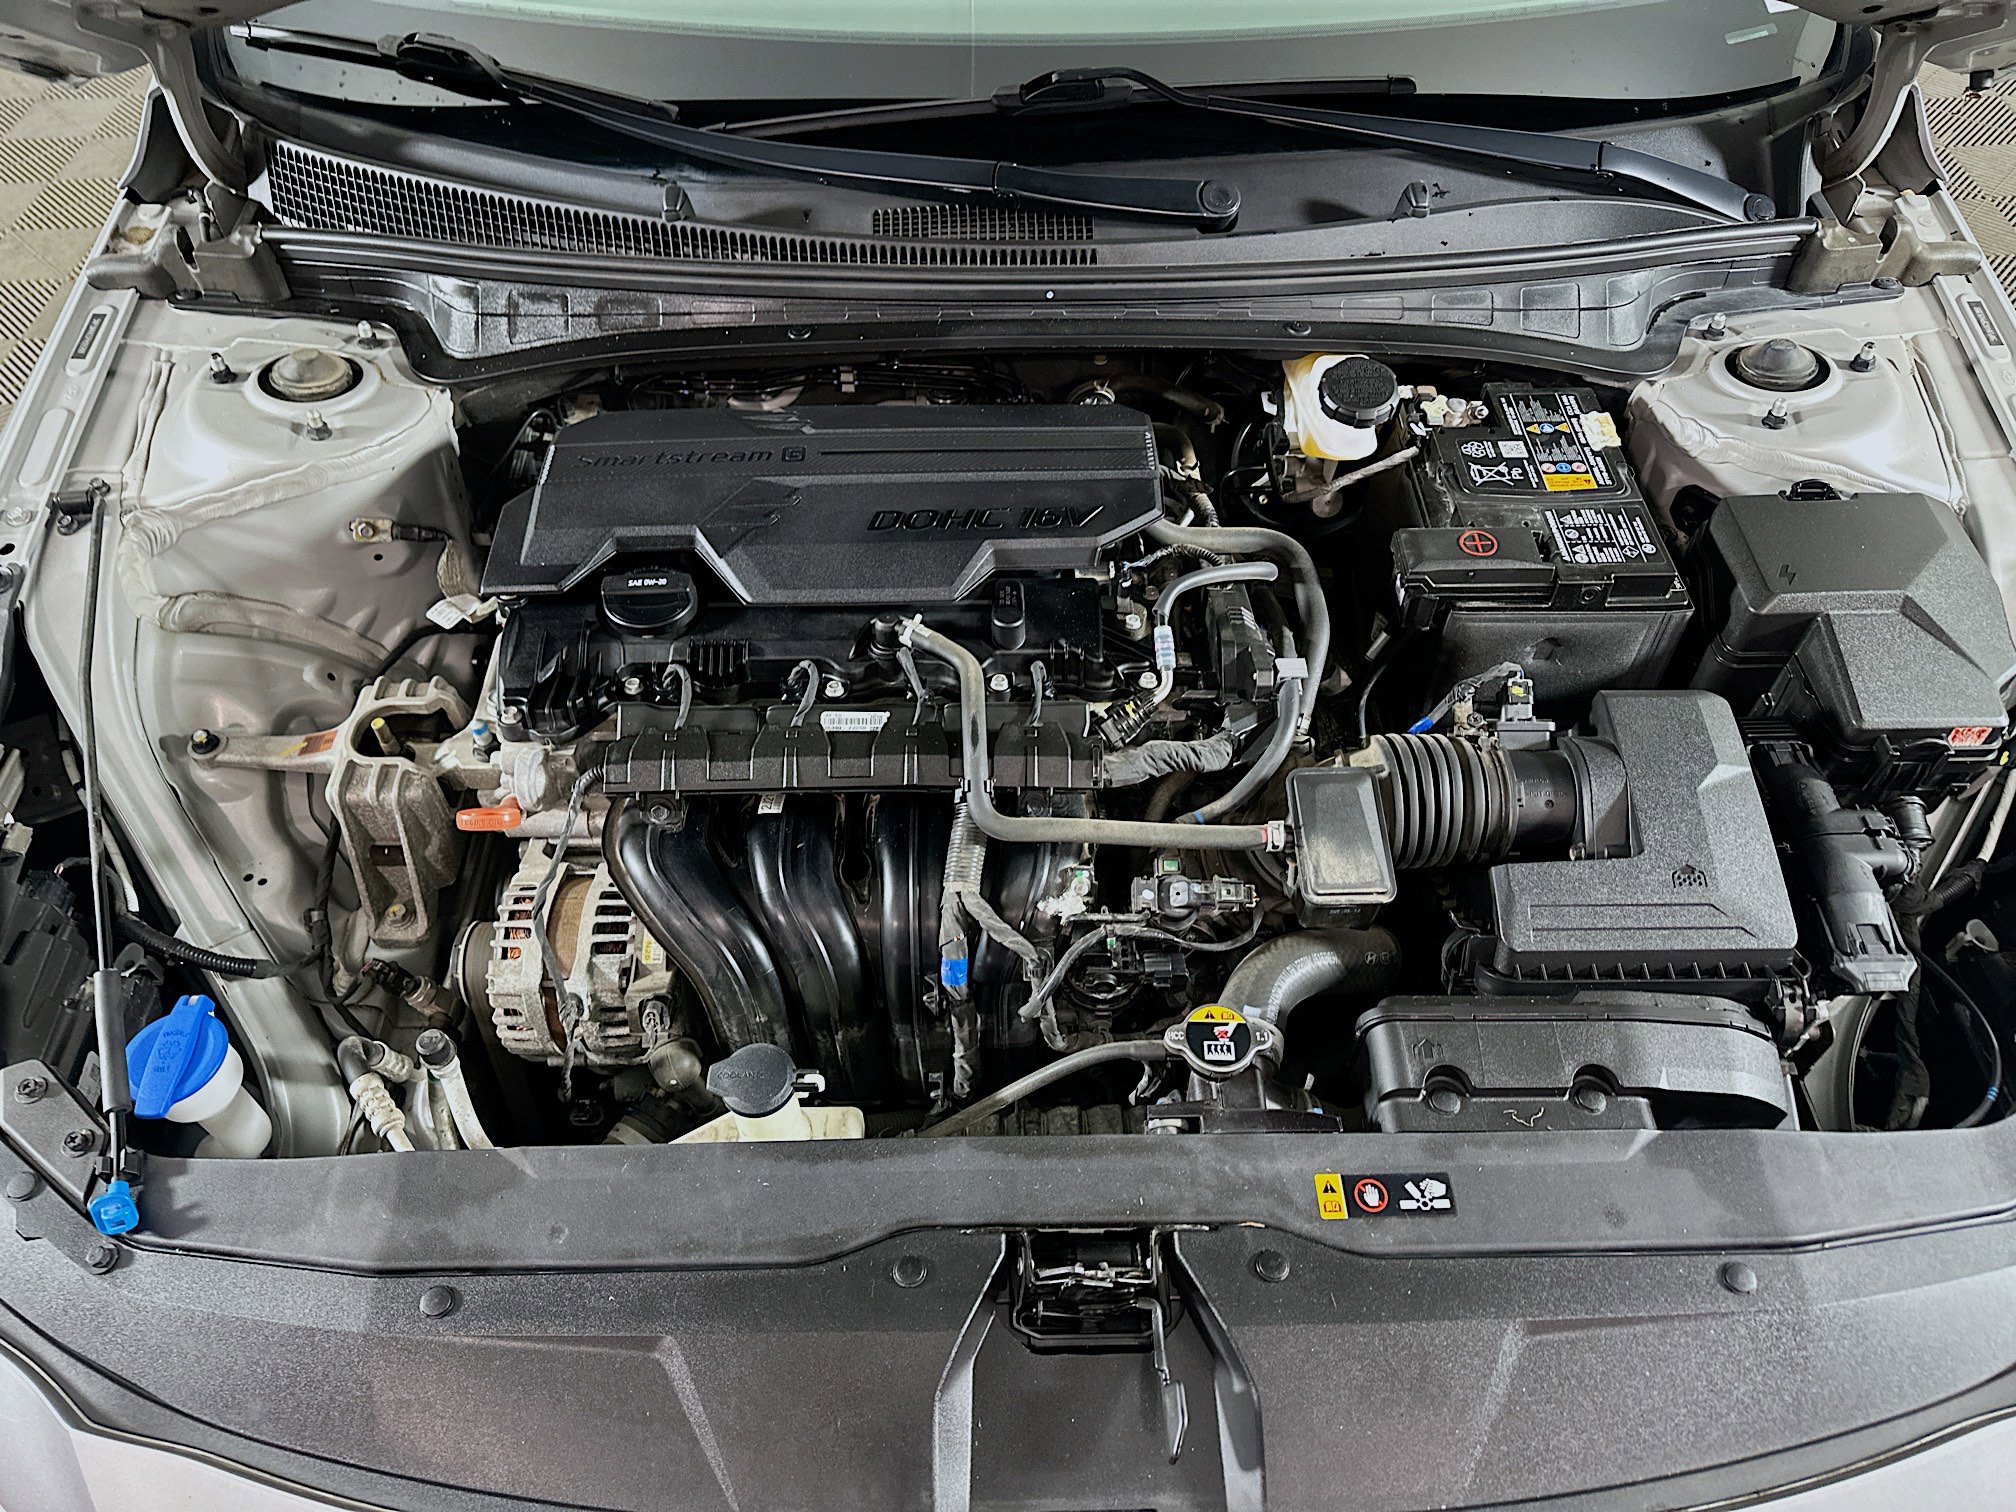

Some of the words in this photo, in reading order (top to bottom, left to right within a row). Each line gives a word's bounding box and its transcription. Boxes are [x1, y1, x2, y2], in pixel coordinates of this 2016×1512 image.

[578, 449, 774, 467] Smartstream
[867, 507, 1012, 531] DOHC
[1020, 504, 1105, 529] 16V
[627, 579, 643, 587] SAE
[643, 577, 667, 586] 0W-20
[1167, 1030, 1185, 1041] HCC
[1255, 1031, 1269, 1042] 1.1
